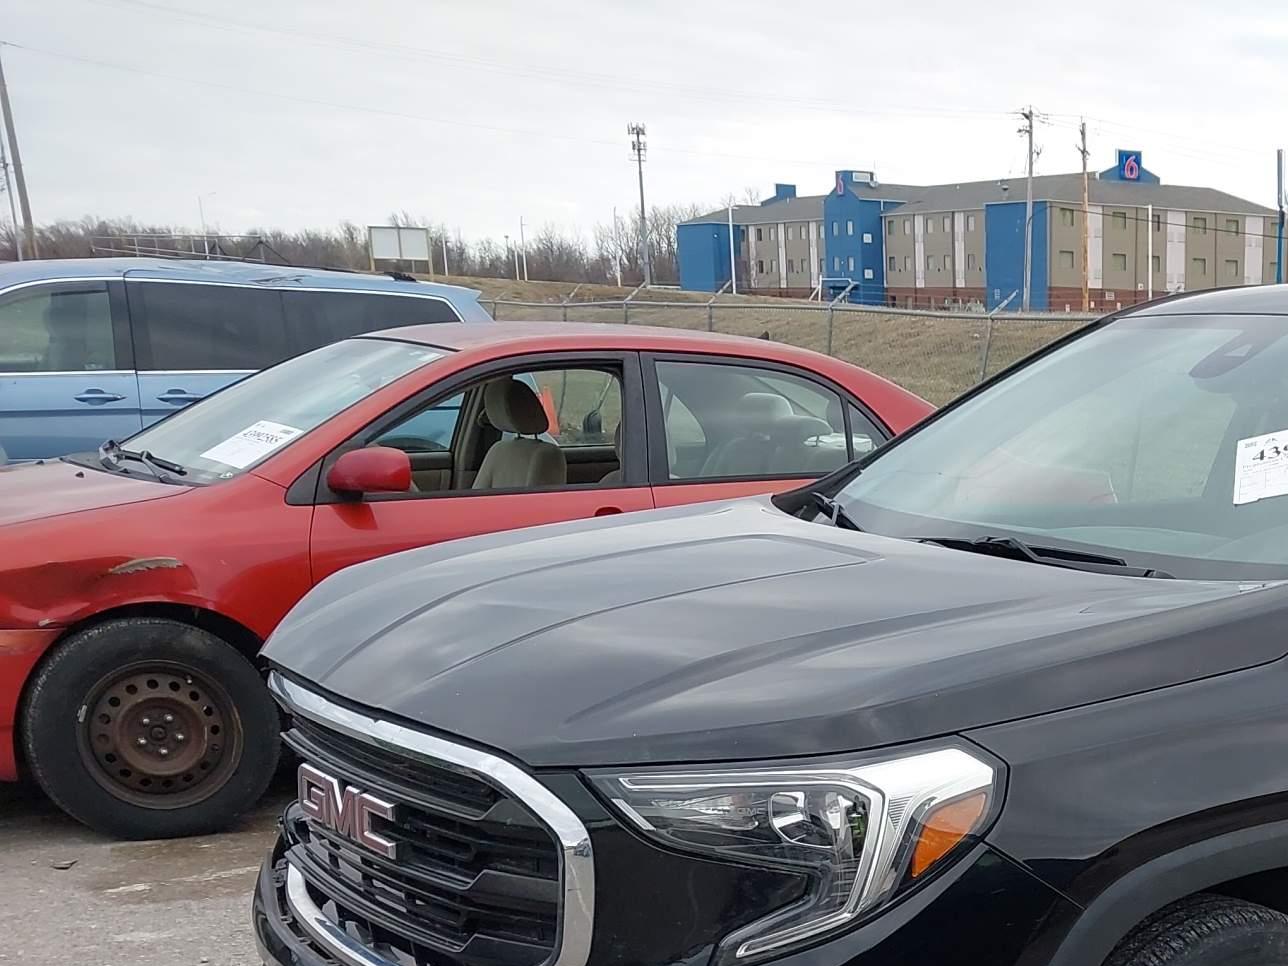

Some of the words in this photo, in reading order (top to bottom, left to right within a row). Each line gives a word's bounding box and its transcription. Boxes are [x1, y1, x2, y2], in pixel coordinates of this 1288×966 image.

[1124, 155, 1139, 179] 6
[298, 763, 396, 860] GMC
[736, 807, 767, 817] GMC
